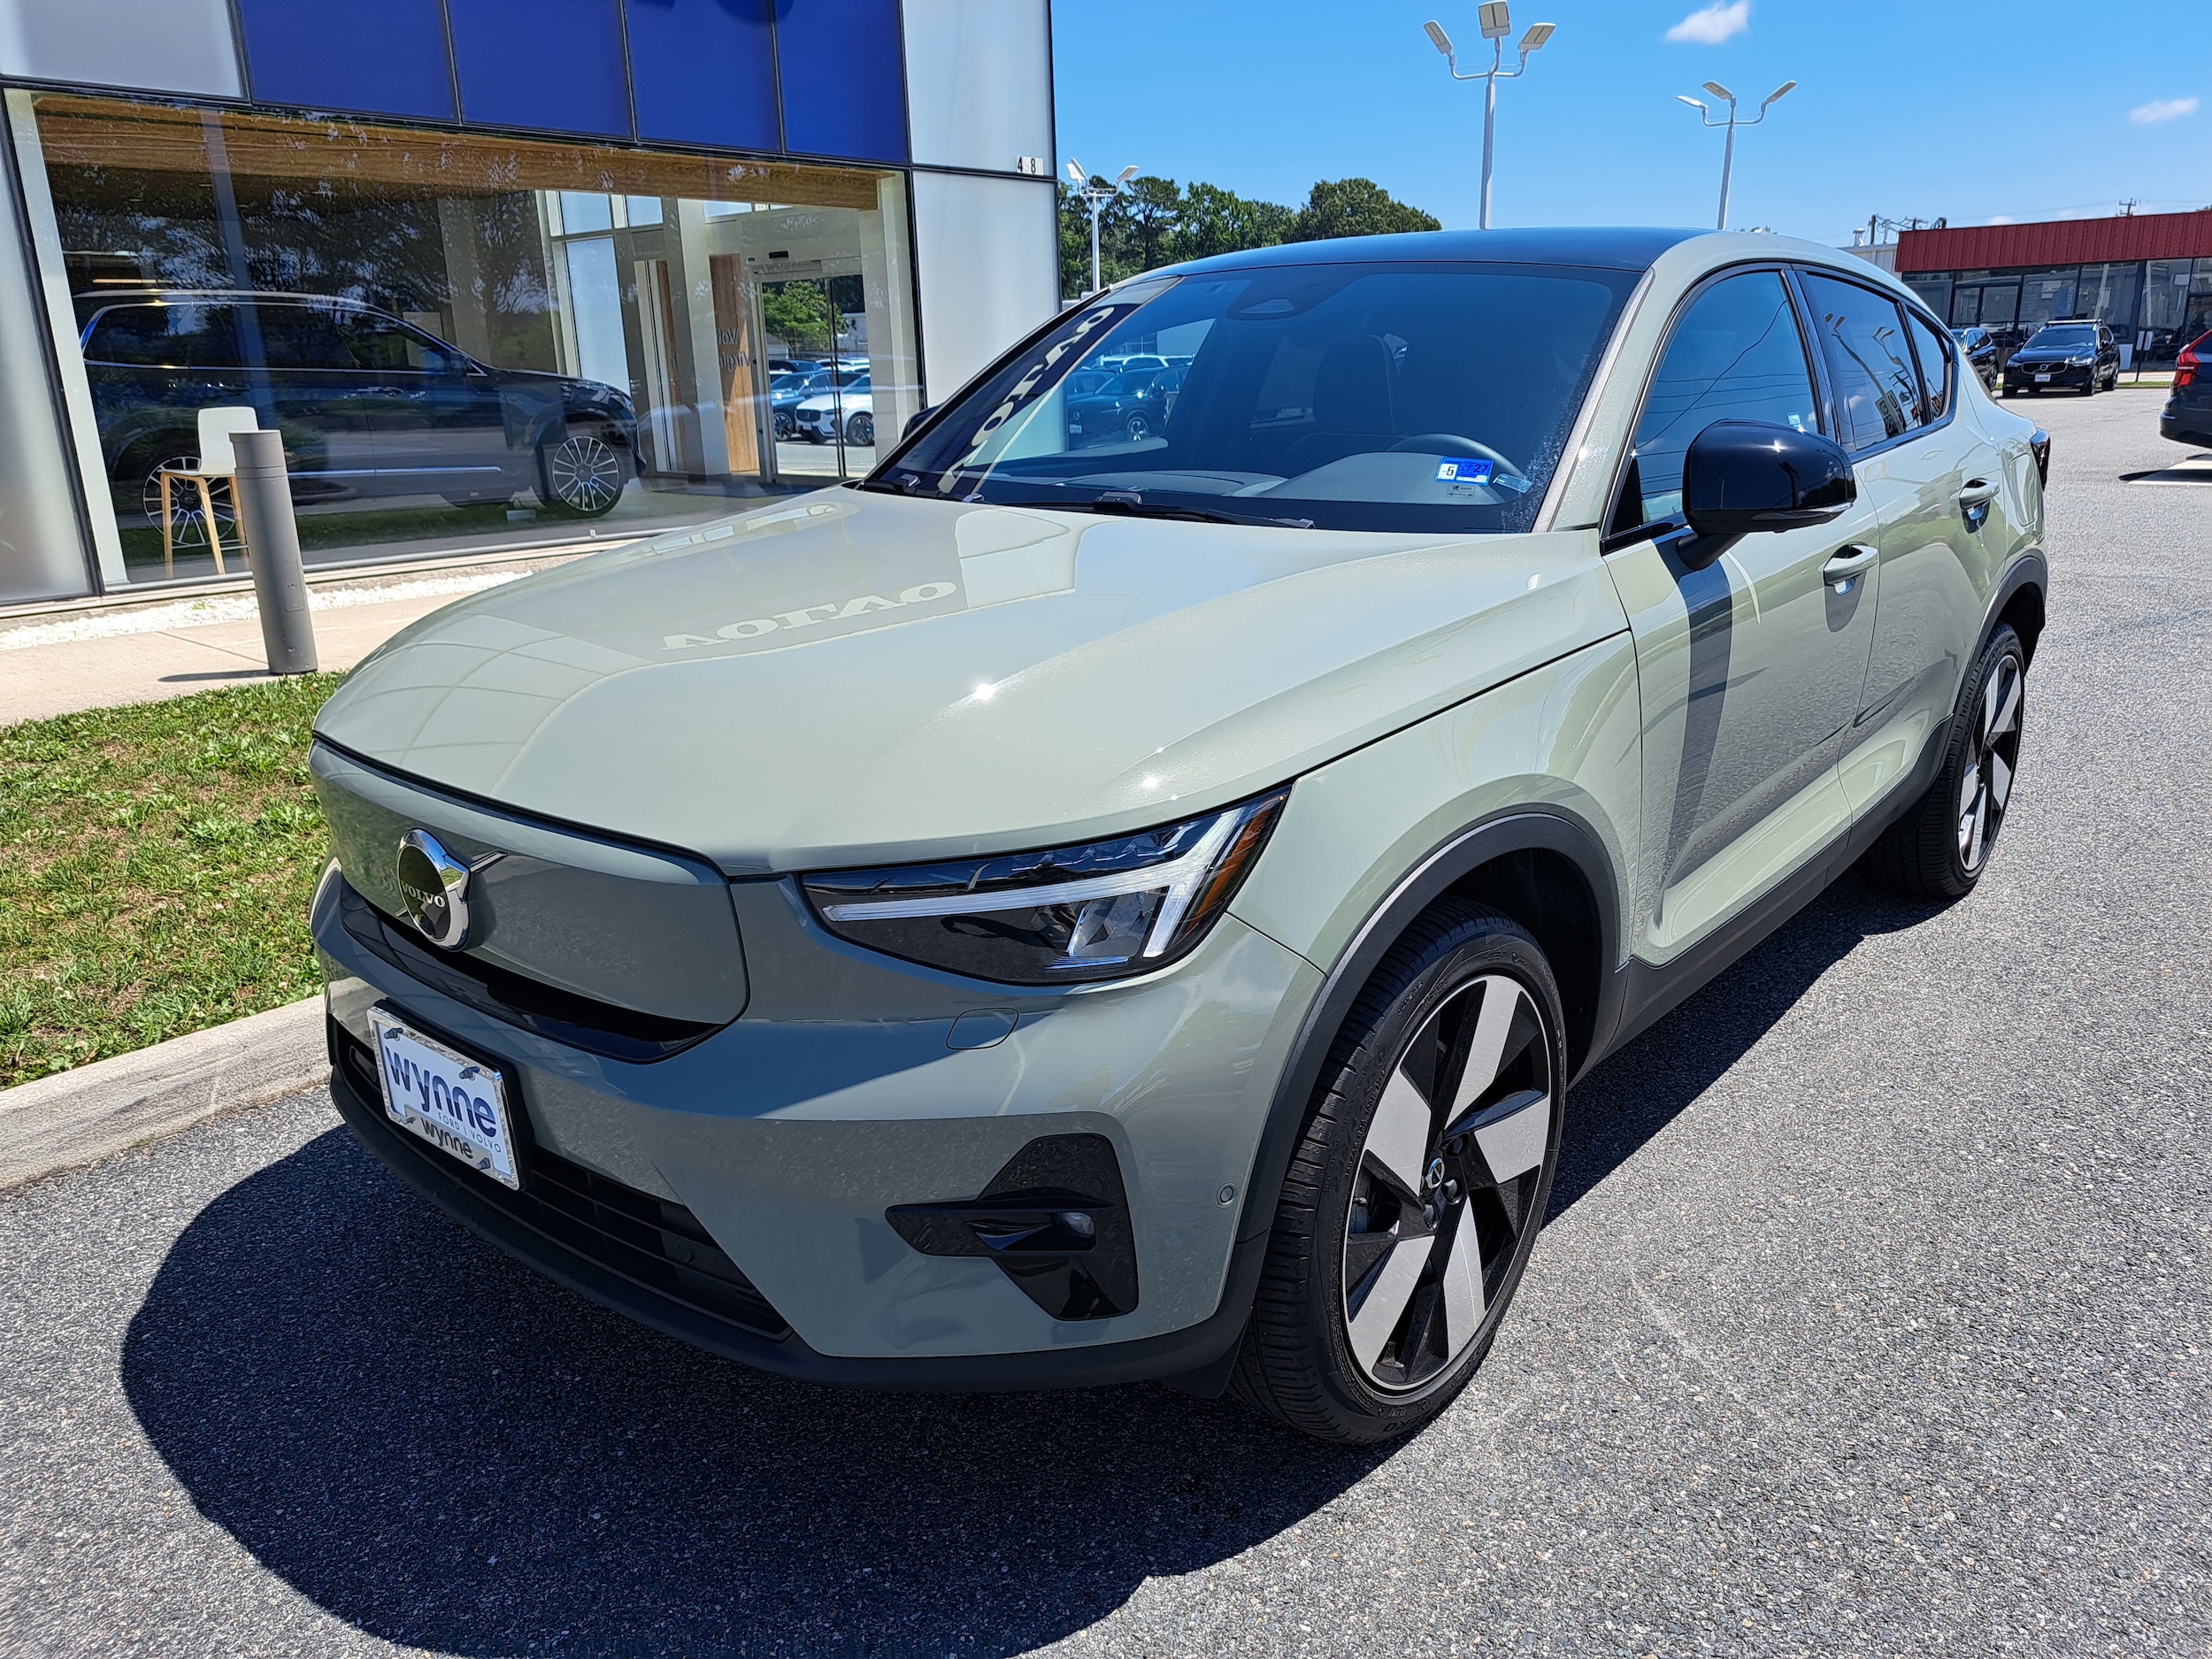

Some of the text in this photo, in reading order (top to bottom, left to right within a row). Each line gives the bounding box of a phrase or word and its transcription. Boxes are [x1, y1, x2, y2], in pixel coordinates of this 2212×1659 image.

[401, 880, 446, 908] VOLVO
[385, 1046, 496, 1137] wynne
[420, 1118, 474, 1159] wynne
[438, 1112, 460, 1131] FORD
[470, 1131, 502, 1153] VOLVO
